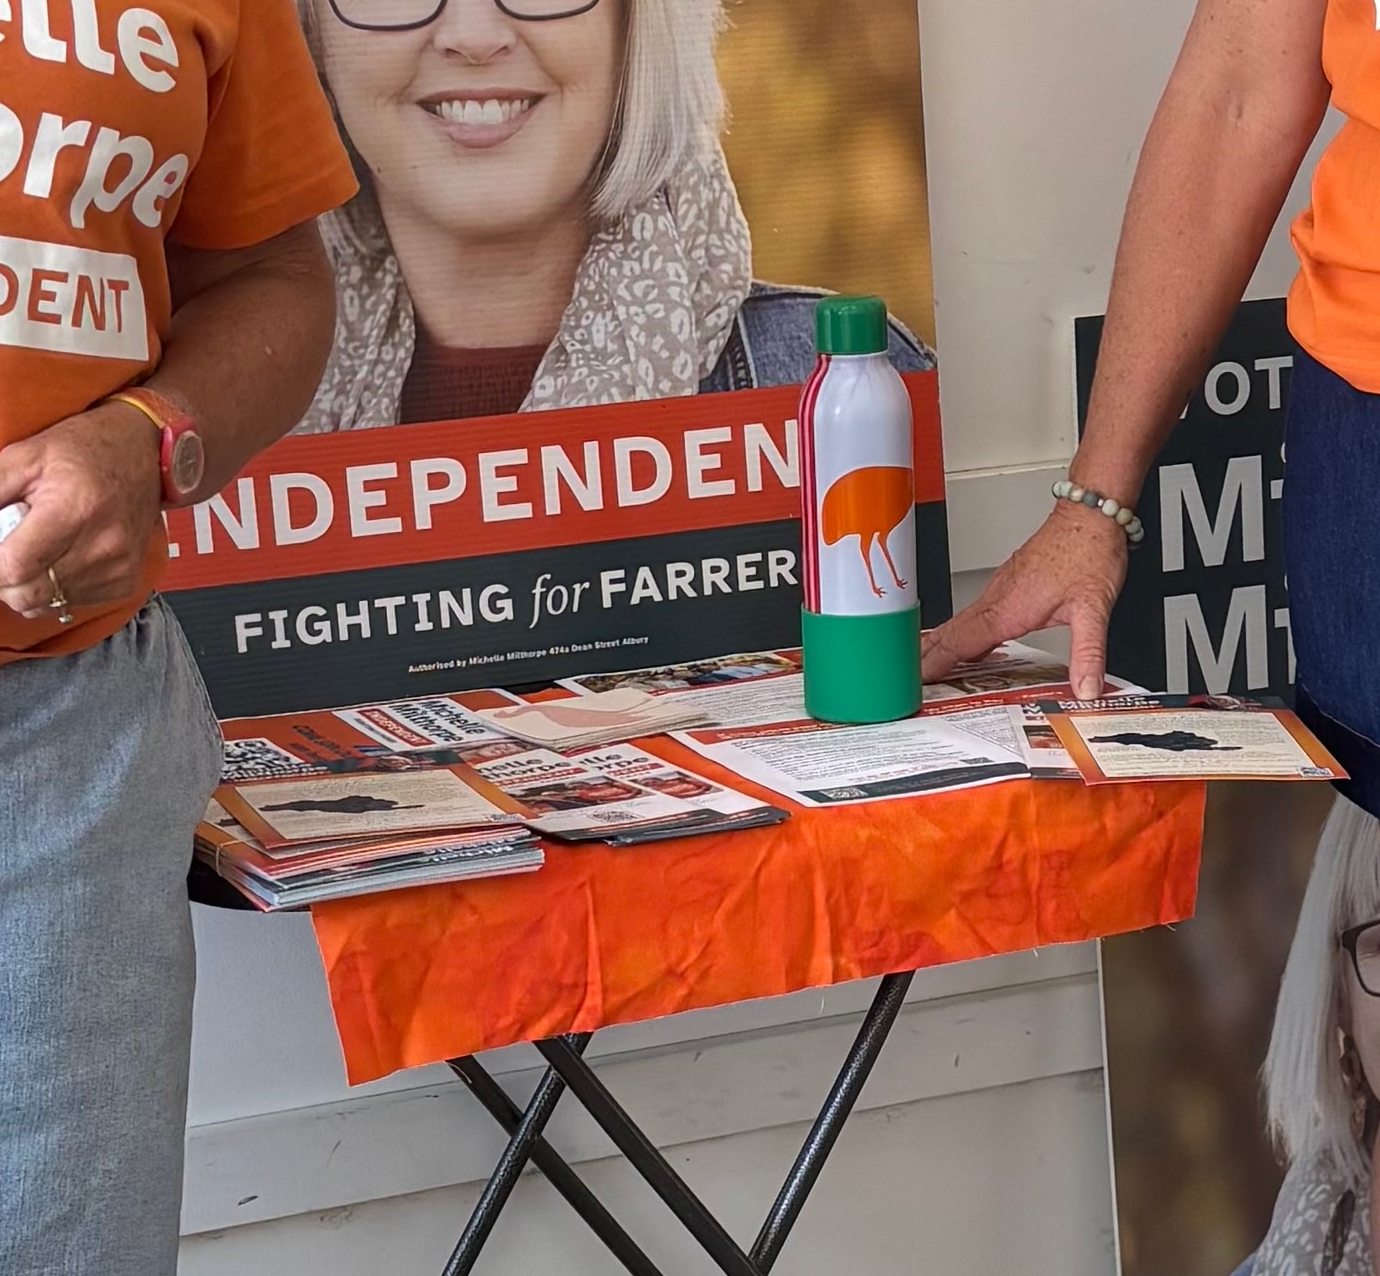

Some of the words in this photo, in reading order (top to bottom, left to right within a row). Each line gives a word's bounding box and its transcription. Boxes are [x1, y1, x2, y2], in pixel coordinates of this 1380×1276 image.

[168, 417, 799, 559] NDEPENDEN
[234, 582, 514, 653] FIGHTING
[529, 572, 590, 630] for
[600, 549, 798, 609] FARRER
